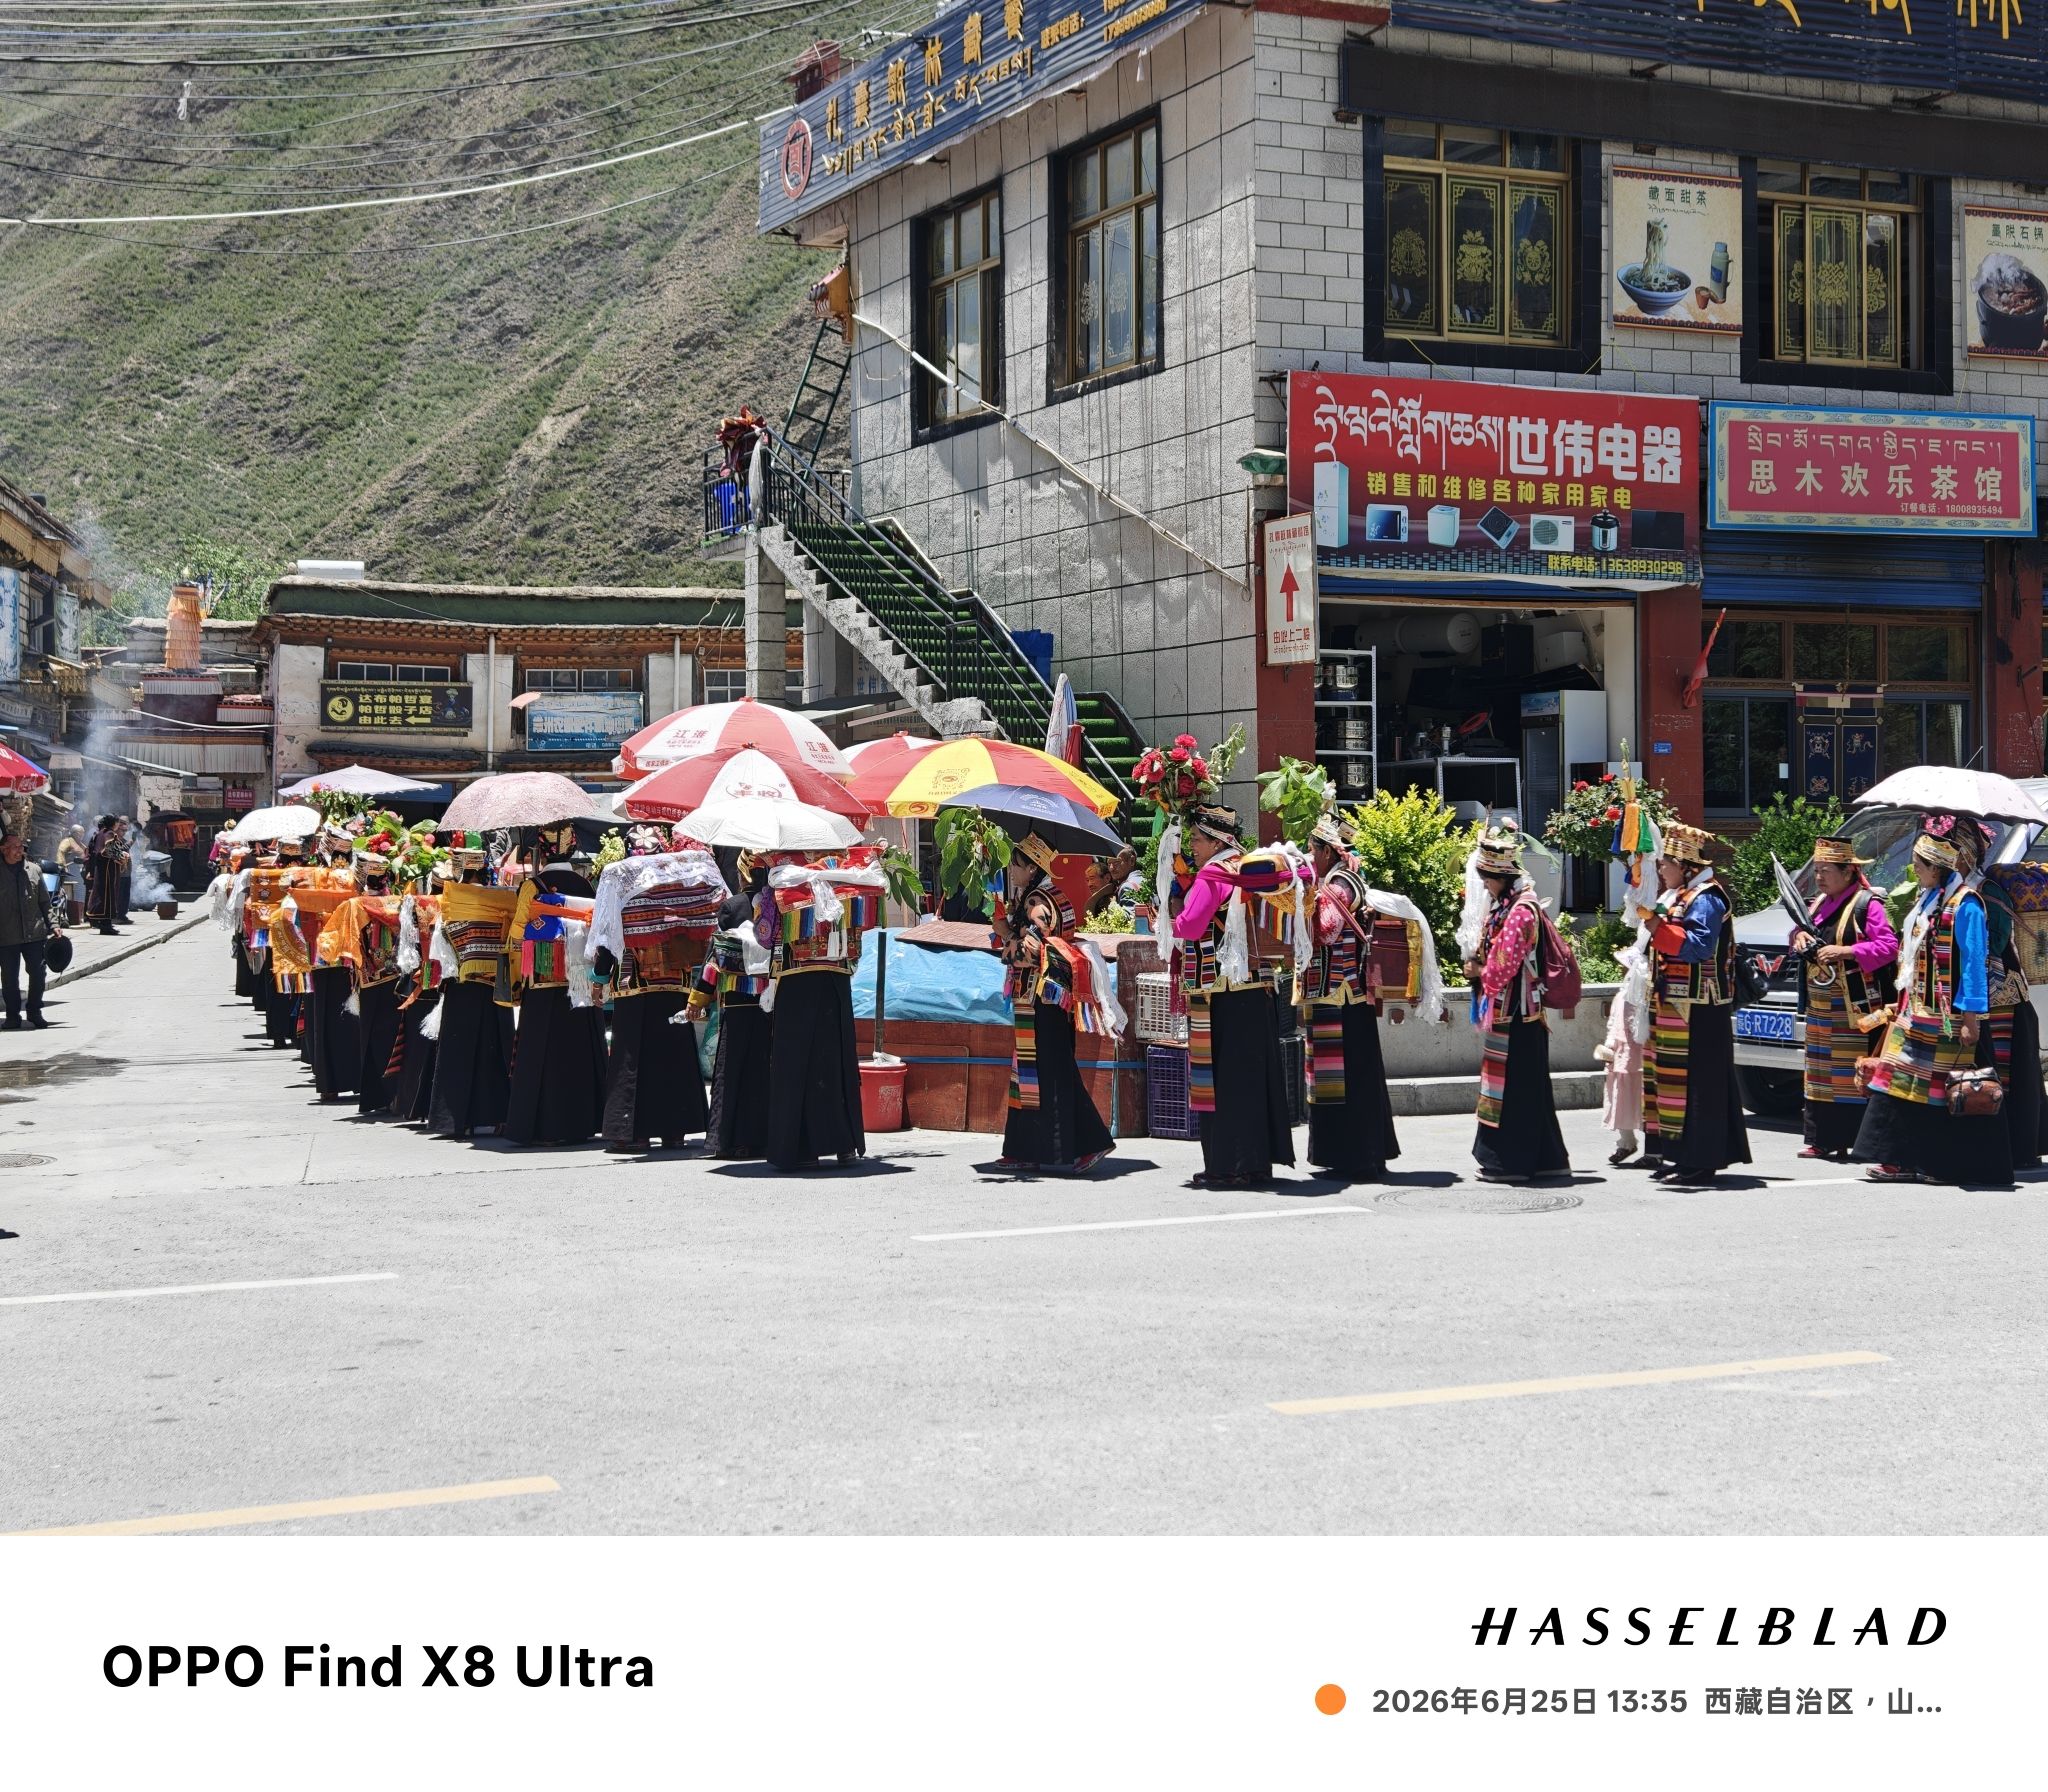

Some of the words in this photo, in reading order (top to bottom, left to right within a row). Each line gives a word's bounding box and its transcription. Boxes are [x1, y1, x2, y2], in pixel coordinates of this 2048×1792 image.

[1648, 185, 1707, 207] 藏面甜茶
[1508, 415, 1682, 484] 世伟电器
[1366, 471, 1632, 510] 销售和维修各种家用家电
[1747, 459, 2002, 502] 思木欢乐茶馆
[358, 715, 403, 725] 由此去
